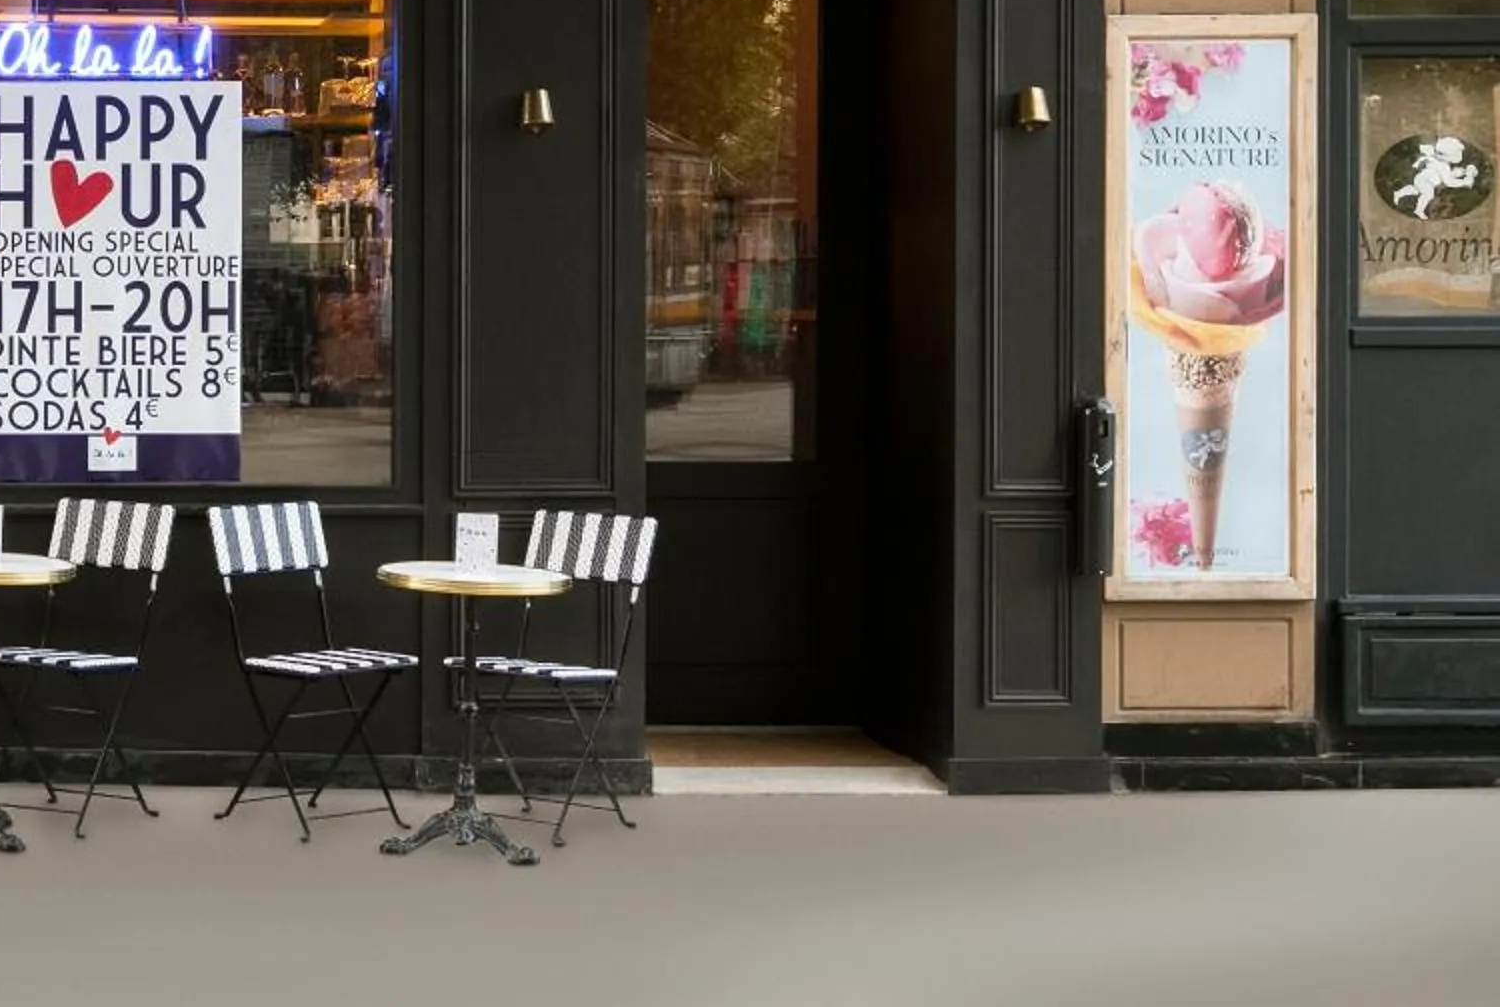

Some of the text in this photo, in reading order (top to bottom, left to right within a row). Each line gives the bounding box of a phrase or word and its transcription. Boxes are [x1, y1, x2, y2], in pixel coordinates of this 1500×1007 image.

[69, 23, 121, 76] la
[132, 23, 185, 76] la
[1139, 148, 1280, 167] SIGNATURE
[105, 231, 199, 254] SPECIAL
[1360, 220, 1500, 263] Amorin
[92, 255, 240, 278] OUVERTURE
[99, 335, 187, 366] BIERE
